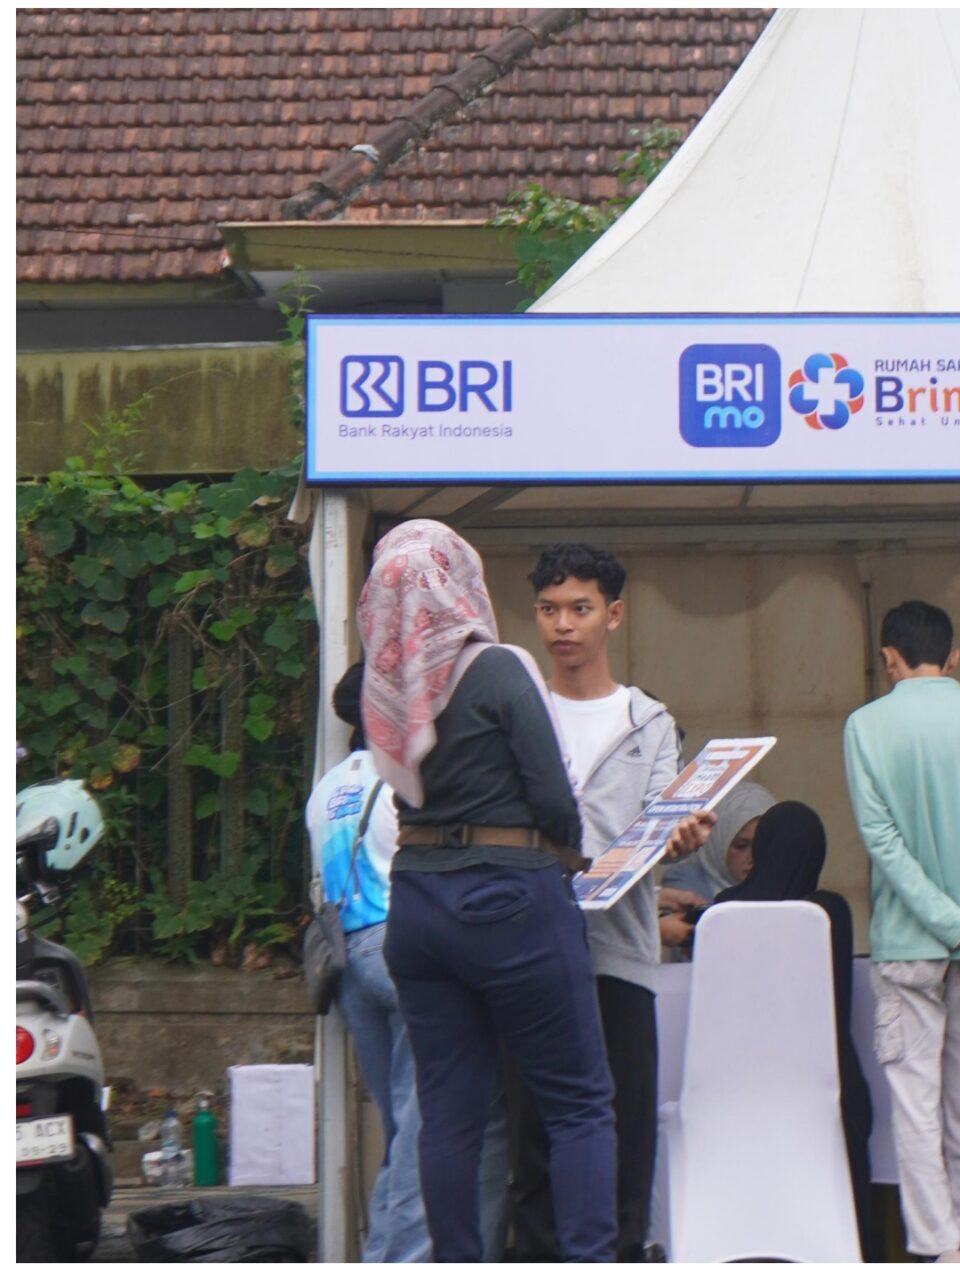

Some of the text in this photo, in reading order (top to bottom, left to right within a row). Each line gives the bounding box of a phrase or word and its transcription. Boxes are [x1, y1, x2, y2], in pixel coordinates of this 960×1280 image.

[874, 359, 931, 372] RUMAH
[417, 360, 512, 412] BRI
[696, 363, 764, 402] BRI
[703, 406, 765, 429] mo
[875, 416, 926, 426] Sehat
[338, 424, 513, 440] Bank Rakyat Indonesia
